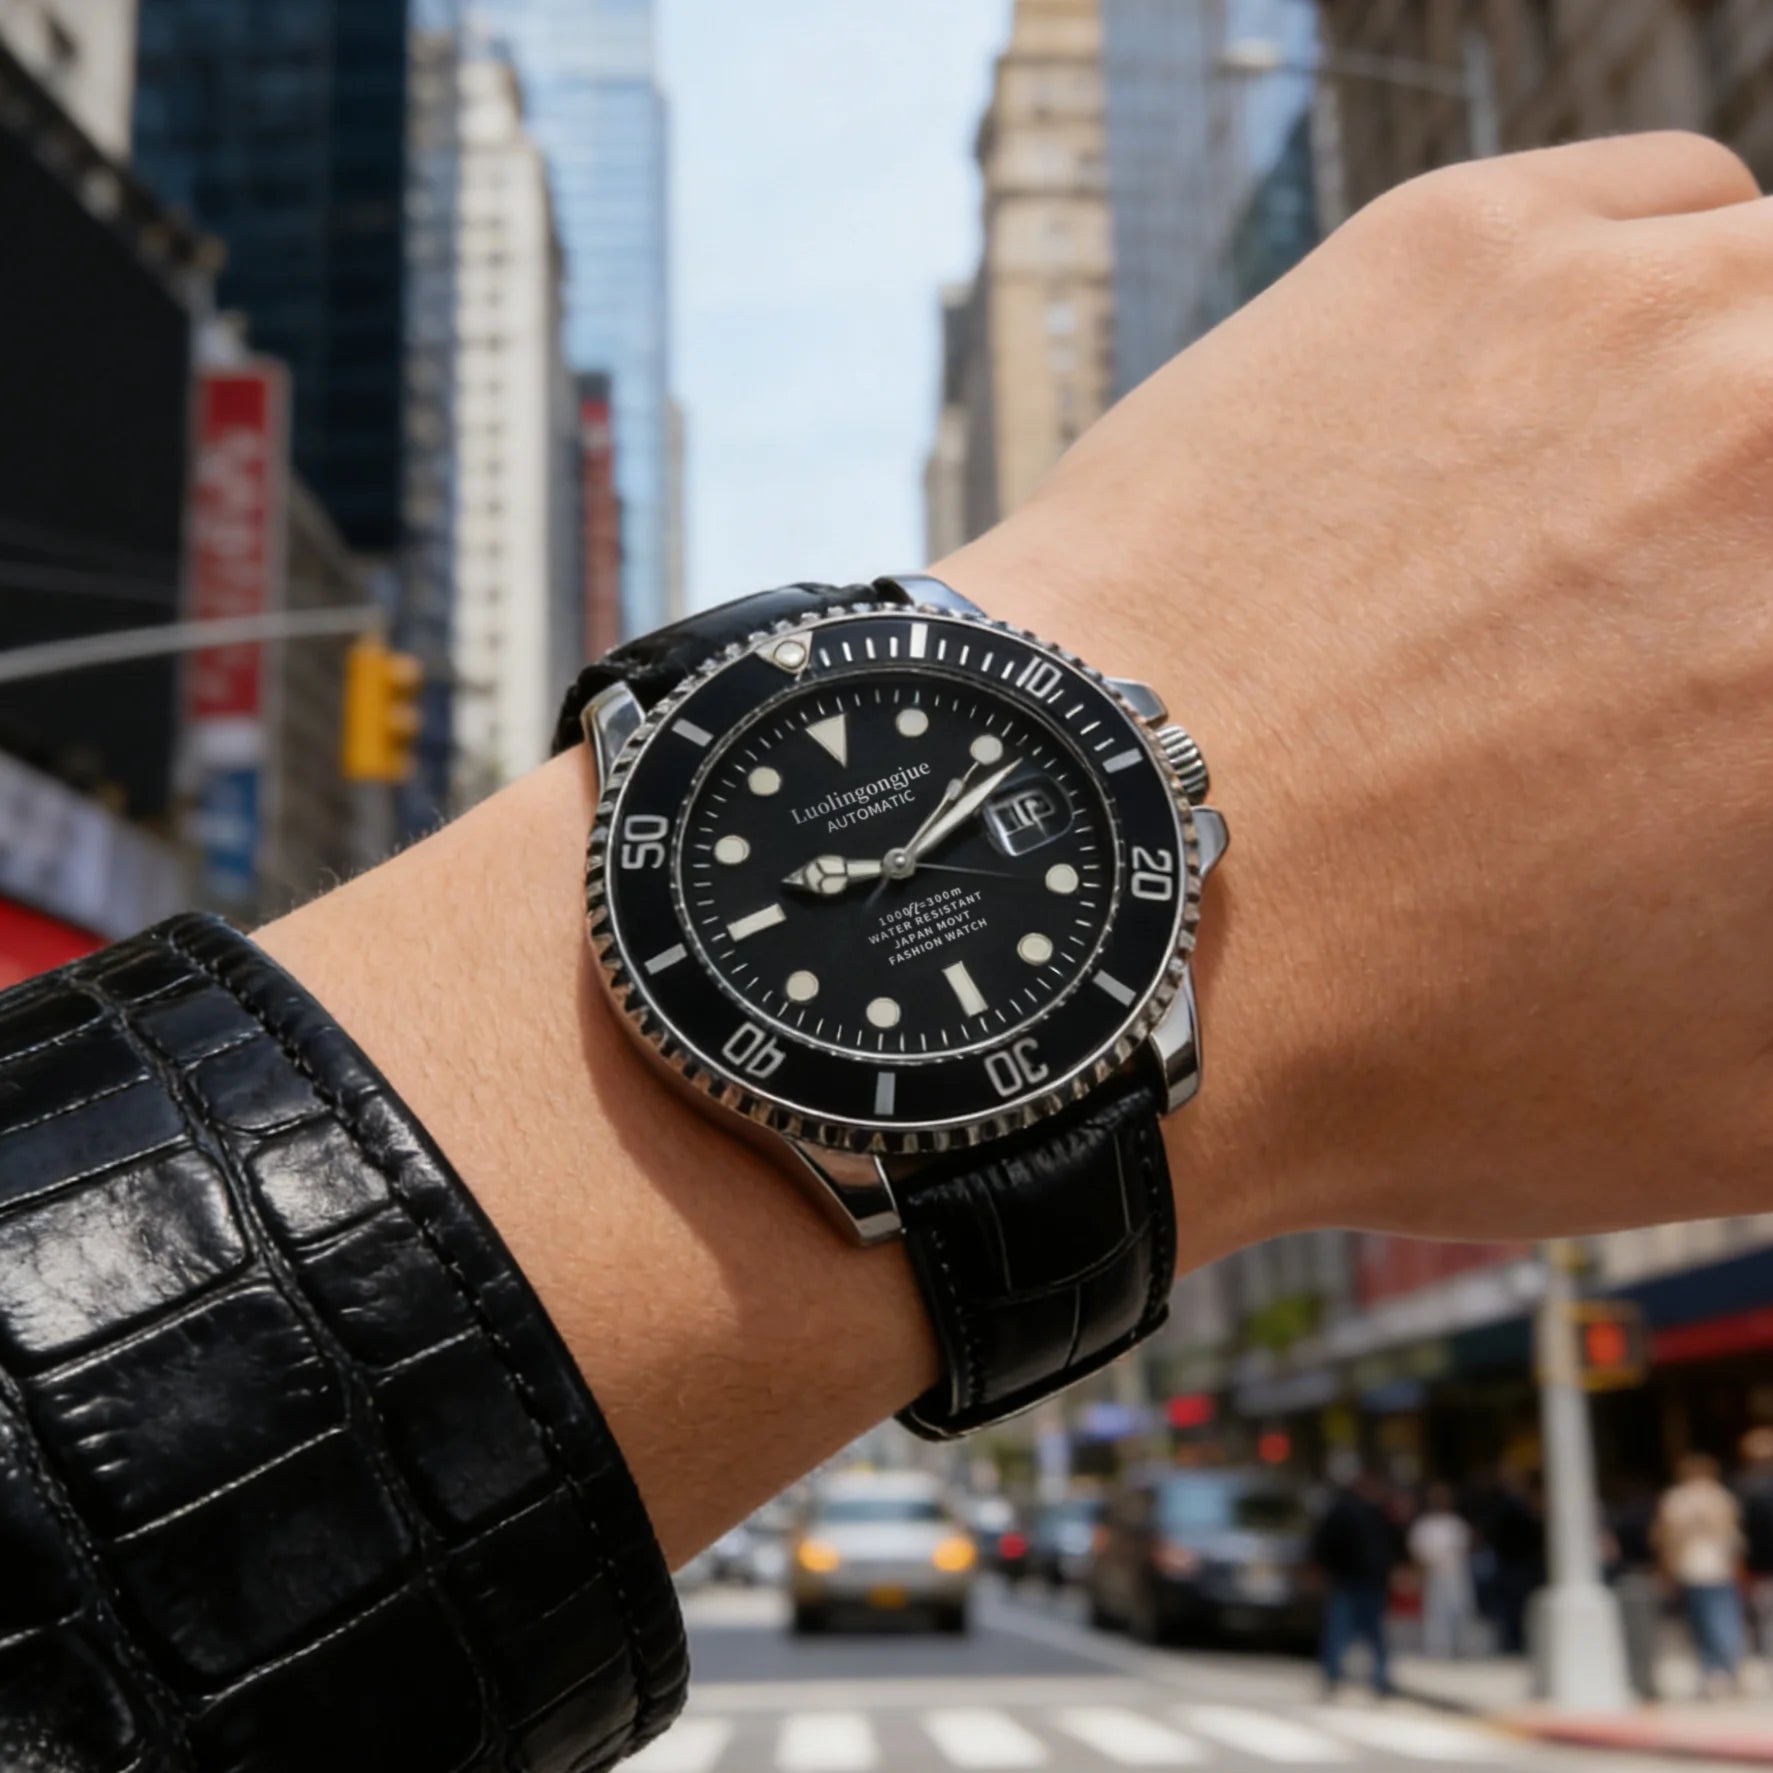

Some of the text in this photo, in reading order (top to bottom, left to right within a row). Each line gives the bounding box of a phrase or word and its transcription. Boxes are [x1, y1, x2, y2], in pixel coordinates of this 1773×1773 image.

[1016, 656, 1062, 698] 10
[790, 762, 931, 824] Luolingongjue
[827, 789, 916, 833] AUTOMATIC
[621, 815, 668, 869] 50
[1131, 846, 1172, 901] 20
[868, 891, 982, 945] WATER RESISTANT
[888, 917, 988, 966] FASHION WATCH
[894, 910, 971, 949] JAPAN MOVT
